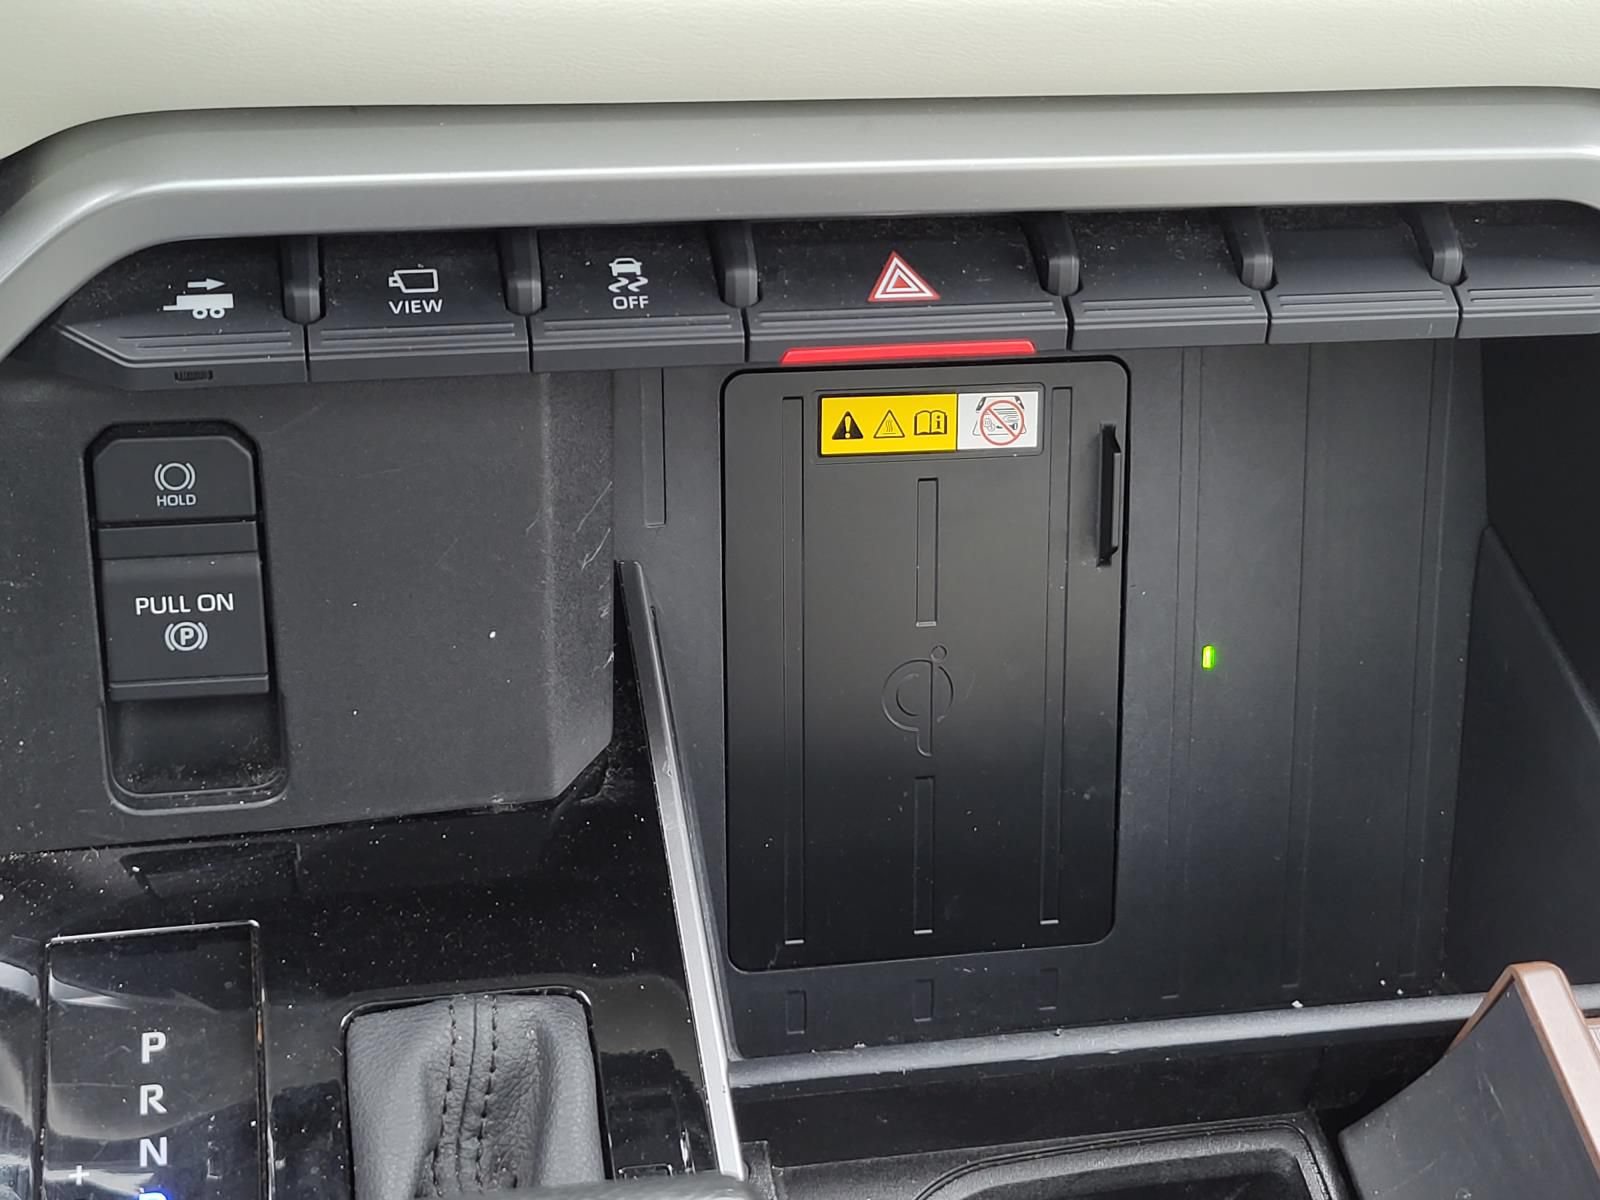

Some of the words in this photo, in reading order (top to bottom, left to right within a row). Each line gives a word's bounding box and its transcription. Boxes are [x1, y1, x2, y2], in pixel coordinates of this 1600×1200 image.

[388, 298, 443, 315] VIEW
[612, 295, 649, 310] OFF
[156, 493, 197, 507] HOLD
[135, 595, 191, 616] PULL
[197, 592, 234, 612] ON
[141, 1031, 166, 1064] P
[139, 1083, 168, 1115] R
[139, 1136, 168, 1168] N
